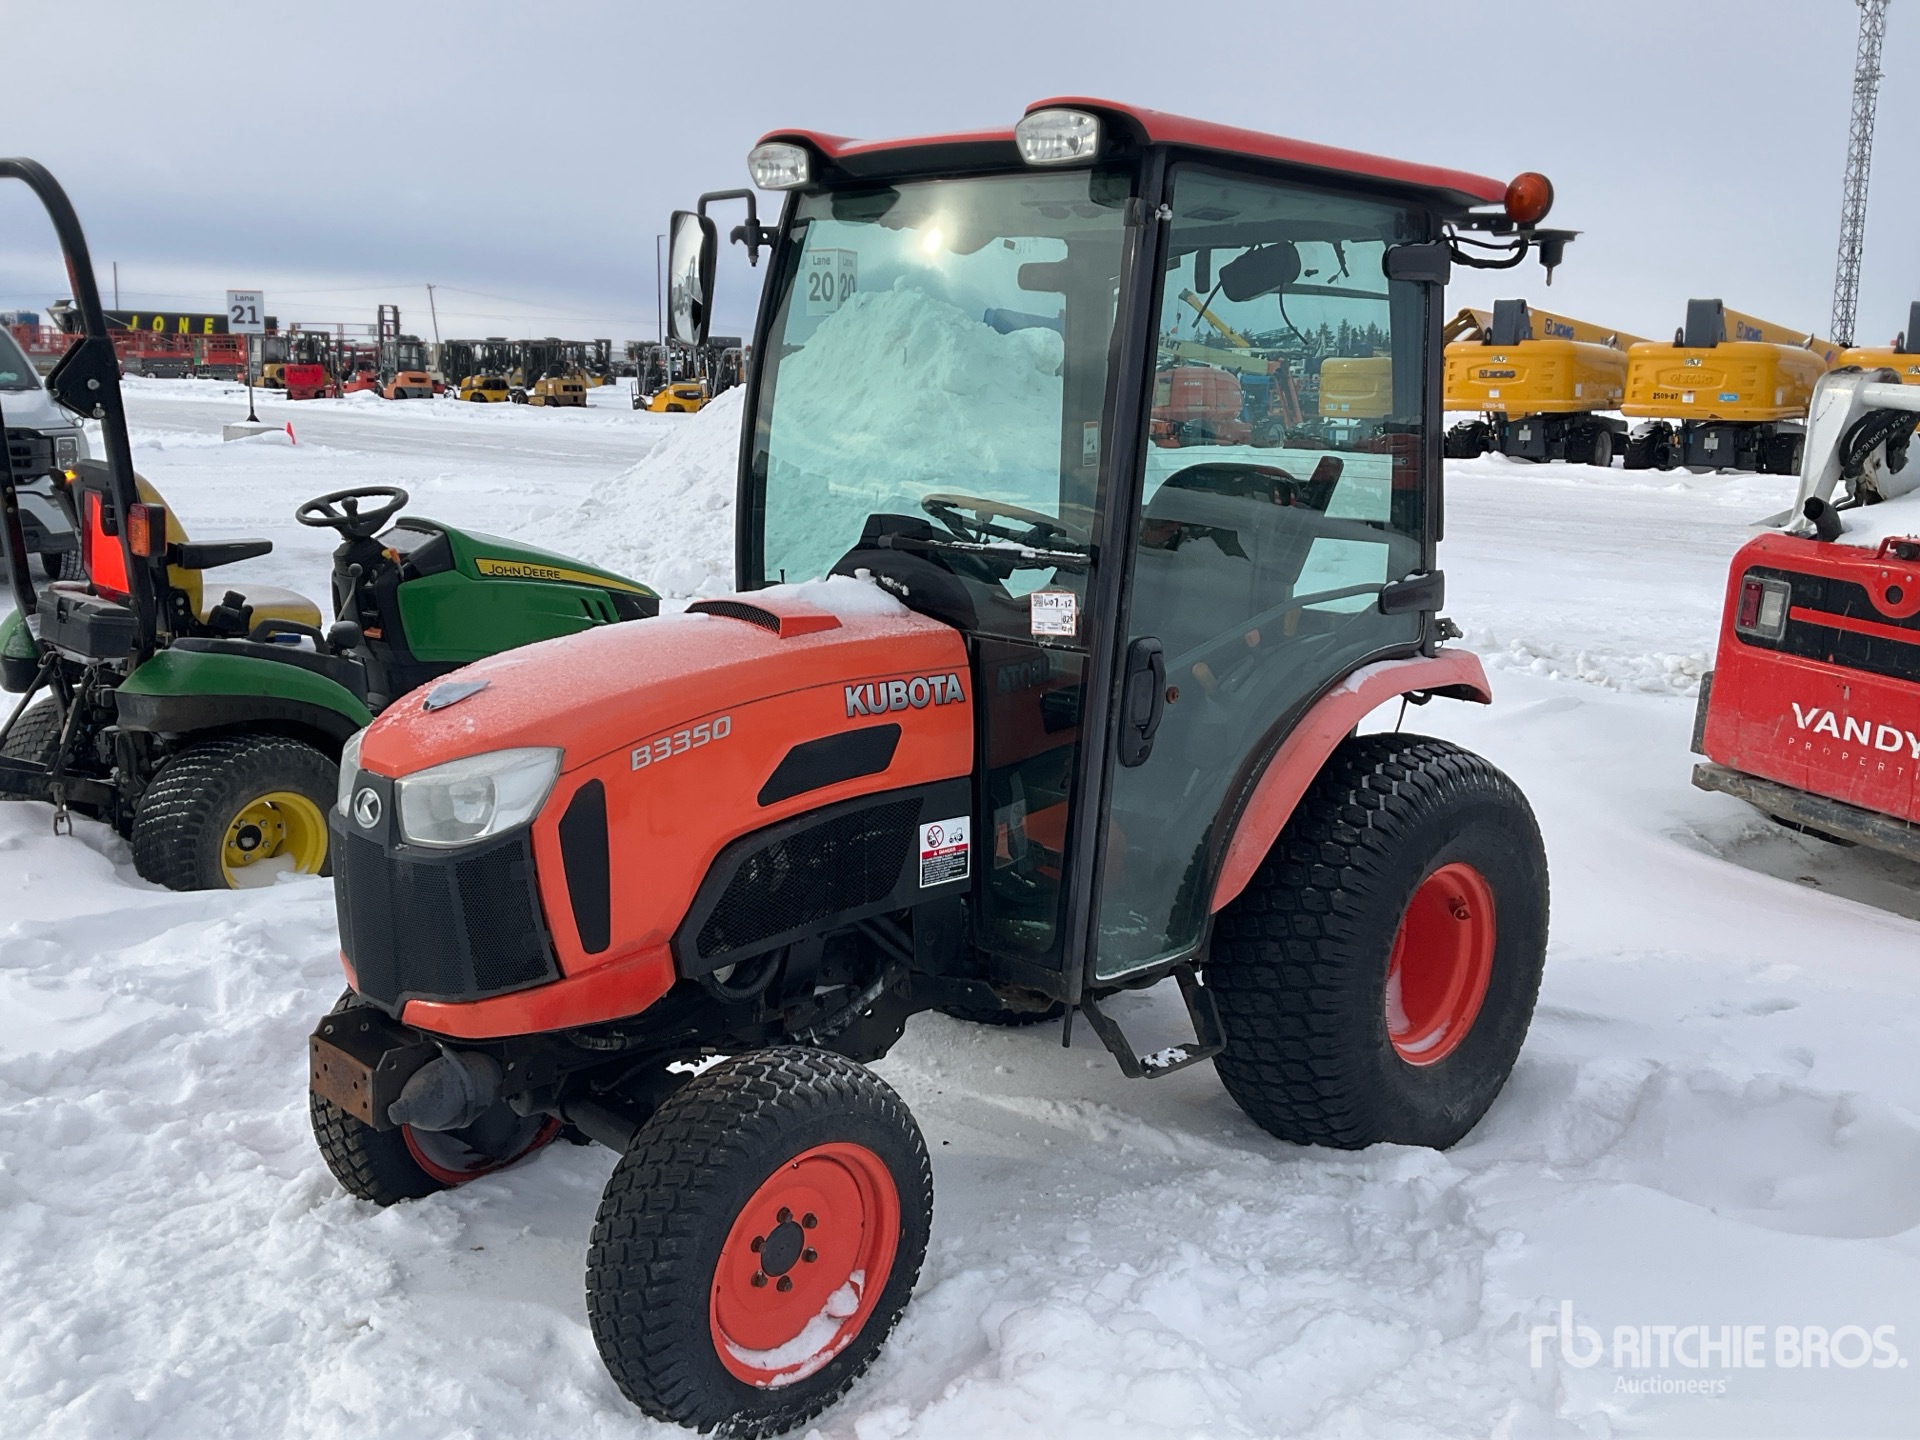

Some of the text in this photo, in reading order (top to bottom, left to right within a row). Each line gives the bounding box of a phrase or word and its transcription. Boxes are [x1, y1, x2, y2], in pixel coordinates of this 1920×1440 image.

[812, 255, 831, 266] Lane
[234, 293, 255, 302] Lane
[808, 270, 835, 302] 20
[840, 272, 856, 302] 20
[231, 304, 261, 325] 21
[1684, 358, 1702, 367] IPAF
[488, 563, 561, 579] JOHN DEERE
[844, 673, 966, 718] KUBOTA
[630, 715, 731, 772] B3350
[1791, 702, 1920, 760] VANDY
